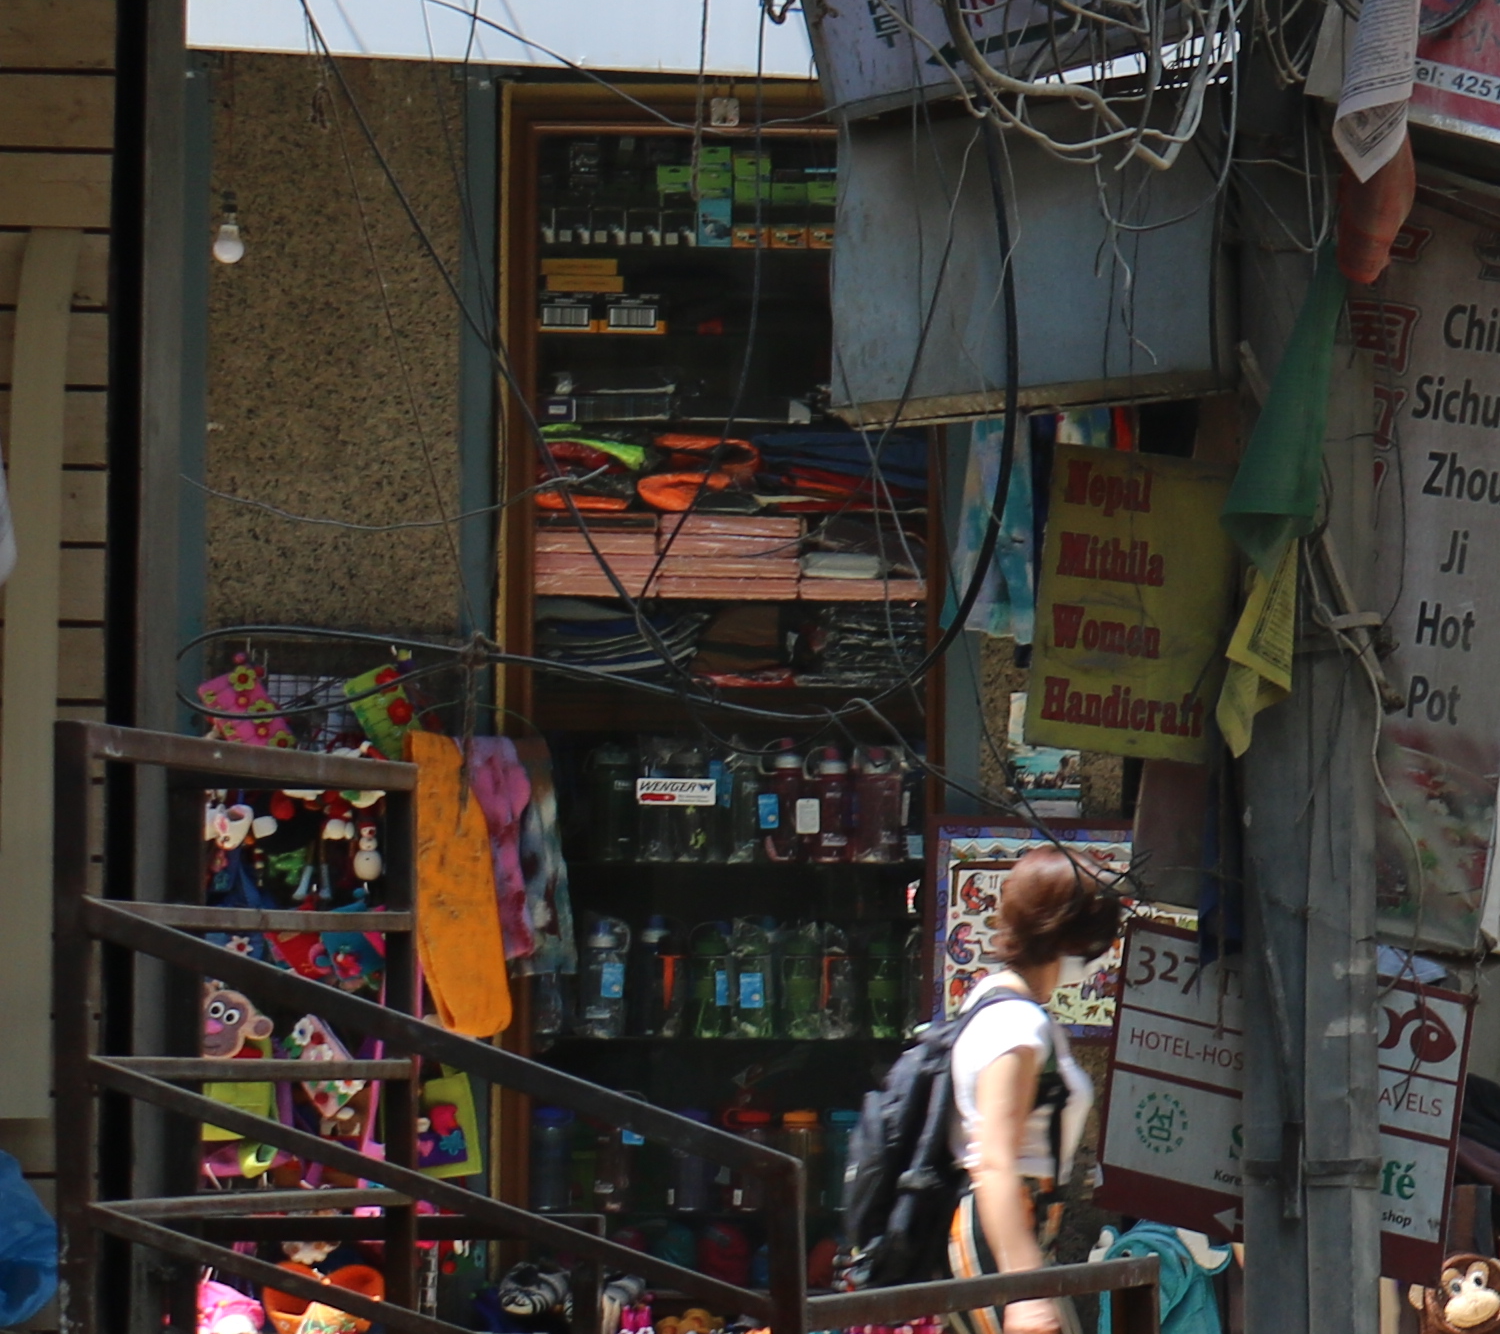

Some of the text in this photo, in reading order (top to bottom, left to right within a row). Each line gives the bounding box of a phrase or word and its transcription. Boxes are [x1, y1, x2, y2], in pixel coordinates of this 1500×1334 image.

[1063, 460, 1152, 517] Nepal
[1057, 531, 1165, 588] Mithila
[1440, 530, 1468, 574] Ji
[1052, 602, 1162, 659] Women
[1416, 602, 1476, 652] Hot
[1407, 675, 1460, 726] Pot
[639, 781, 697, 793] WENGER
[1382, 1209, 1412, 1228] shop
